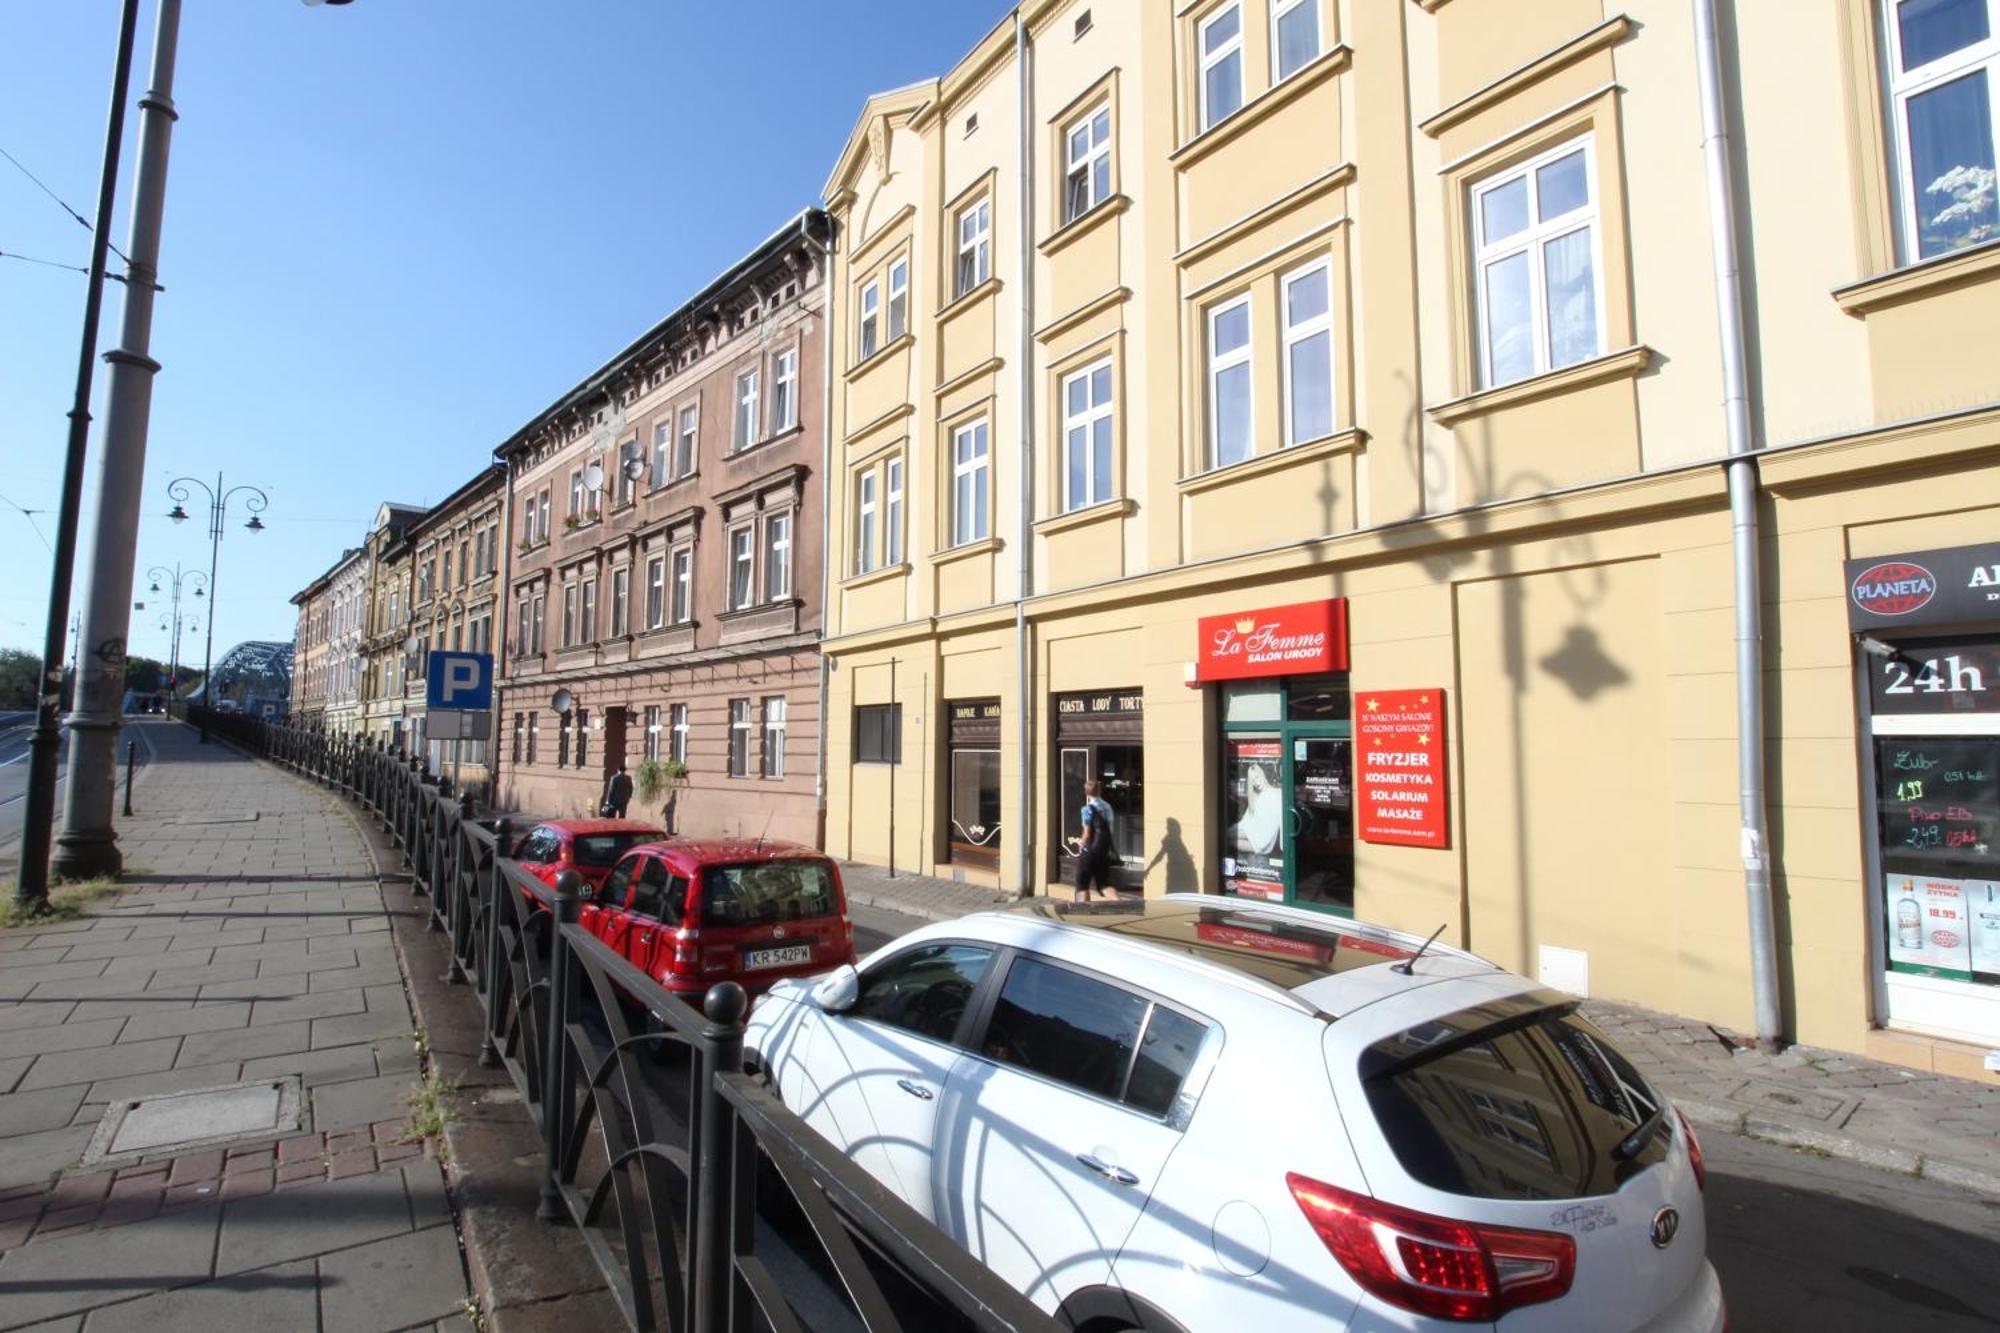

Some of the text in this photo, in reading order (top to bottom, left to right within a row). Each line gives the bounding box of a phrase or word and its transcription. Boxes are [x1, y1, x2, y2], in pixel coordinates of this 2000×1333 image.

[1856, 577, 1931, 600] PLANETA
[1211, 623, 1326, 657] La Femme
[1247, 647, 1324, 664] SALON URODY
[442, 658, 480, 702] P
[1884, 655, 1987, 694] 24h
[1059, 699, 1085, 713] CIASTA
[1092, 695, 1112, 712] LODY
[1367, 752, 1430, 767] FRYZJER
[1365, 773, 1433, 785] KOSMETYKA
[1370, 790, 1429, 803] SOLARIUM
[1376, 807, 1424, 820] MASAŻE
[753, 948, 808, 965] KR 542PW
